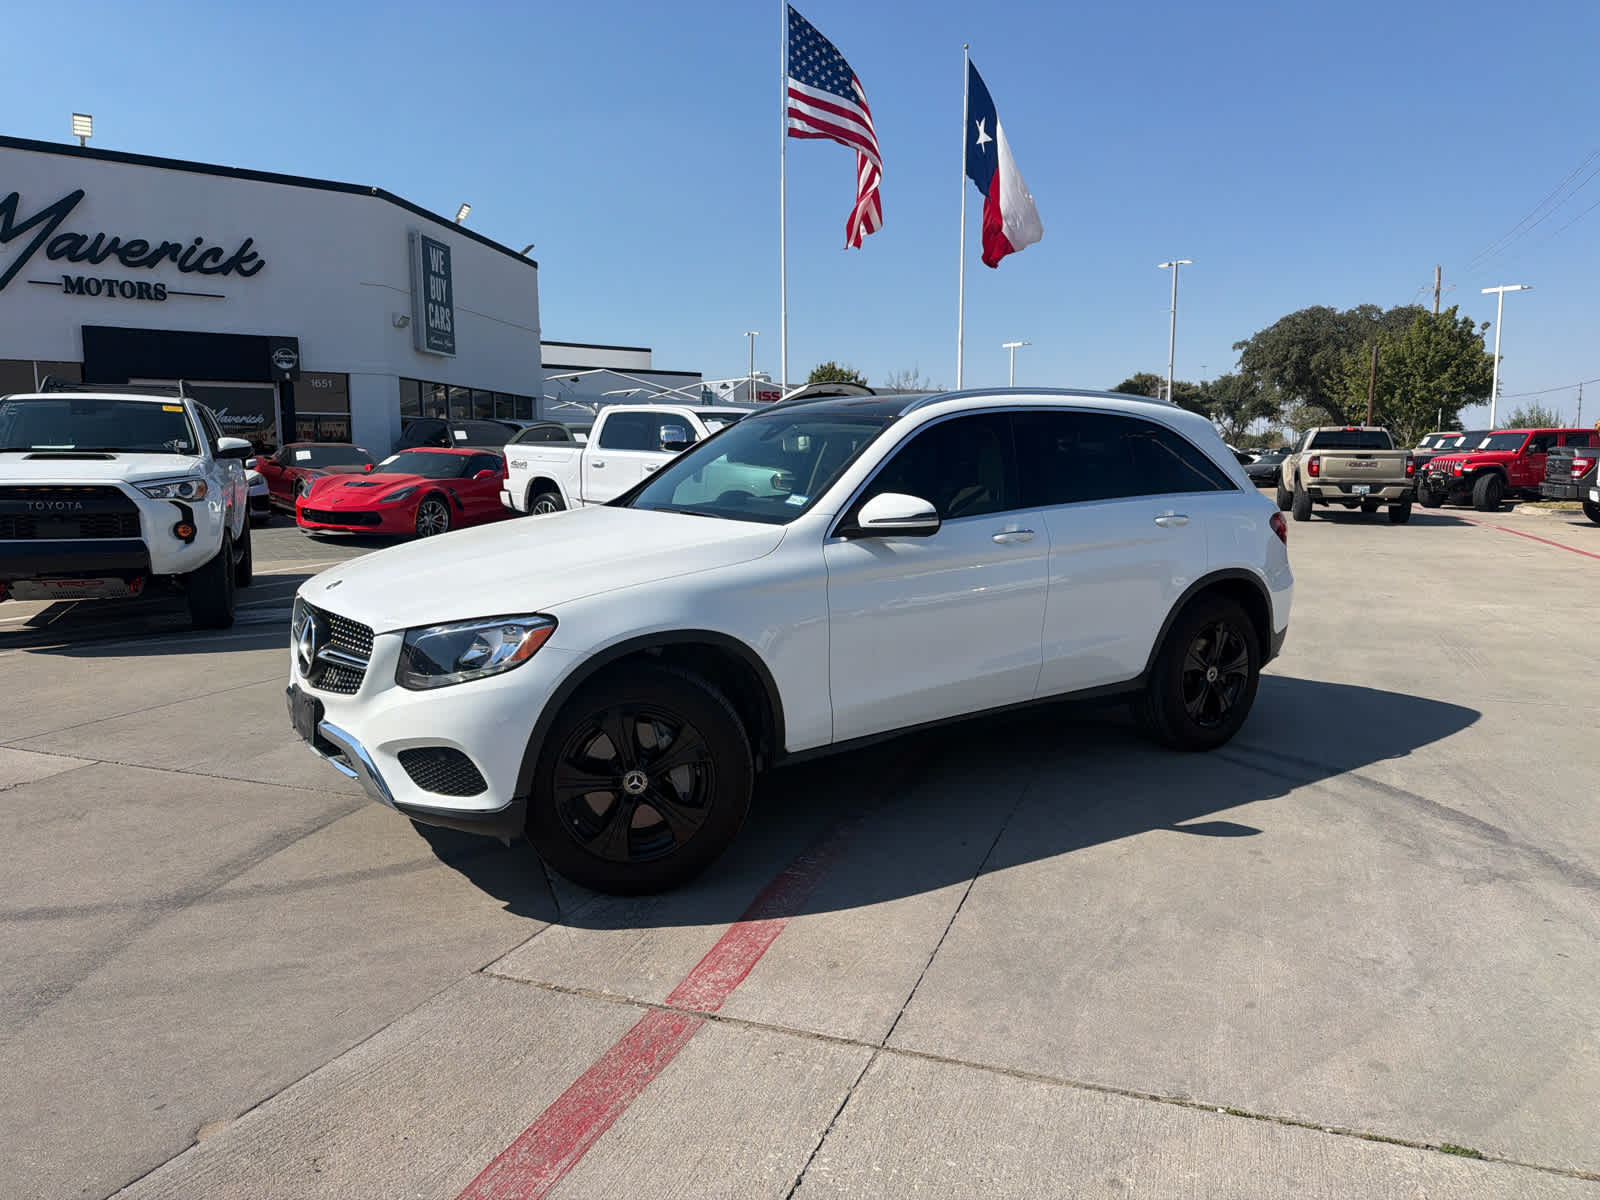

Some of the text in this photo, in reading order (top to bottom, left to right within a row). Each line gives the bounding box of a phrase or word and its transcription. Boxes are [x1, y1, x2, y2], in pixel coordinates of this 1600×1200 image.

[0, 188, 266, 291] Maverick
[429, 246, 445, 275] WE
[62, 275, 168, 301] MOTORS
[430, 274, 447, 303] BUY
[428, 302, 451, 332] CARS
[311, 378, 332, 389] 1651
[26, 501, 83, 511] TOYOTA
